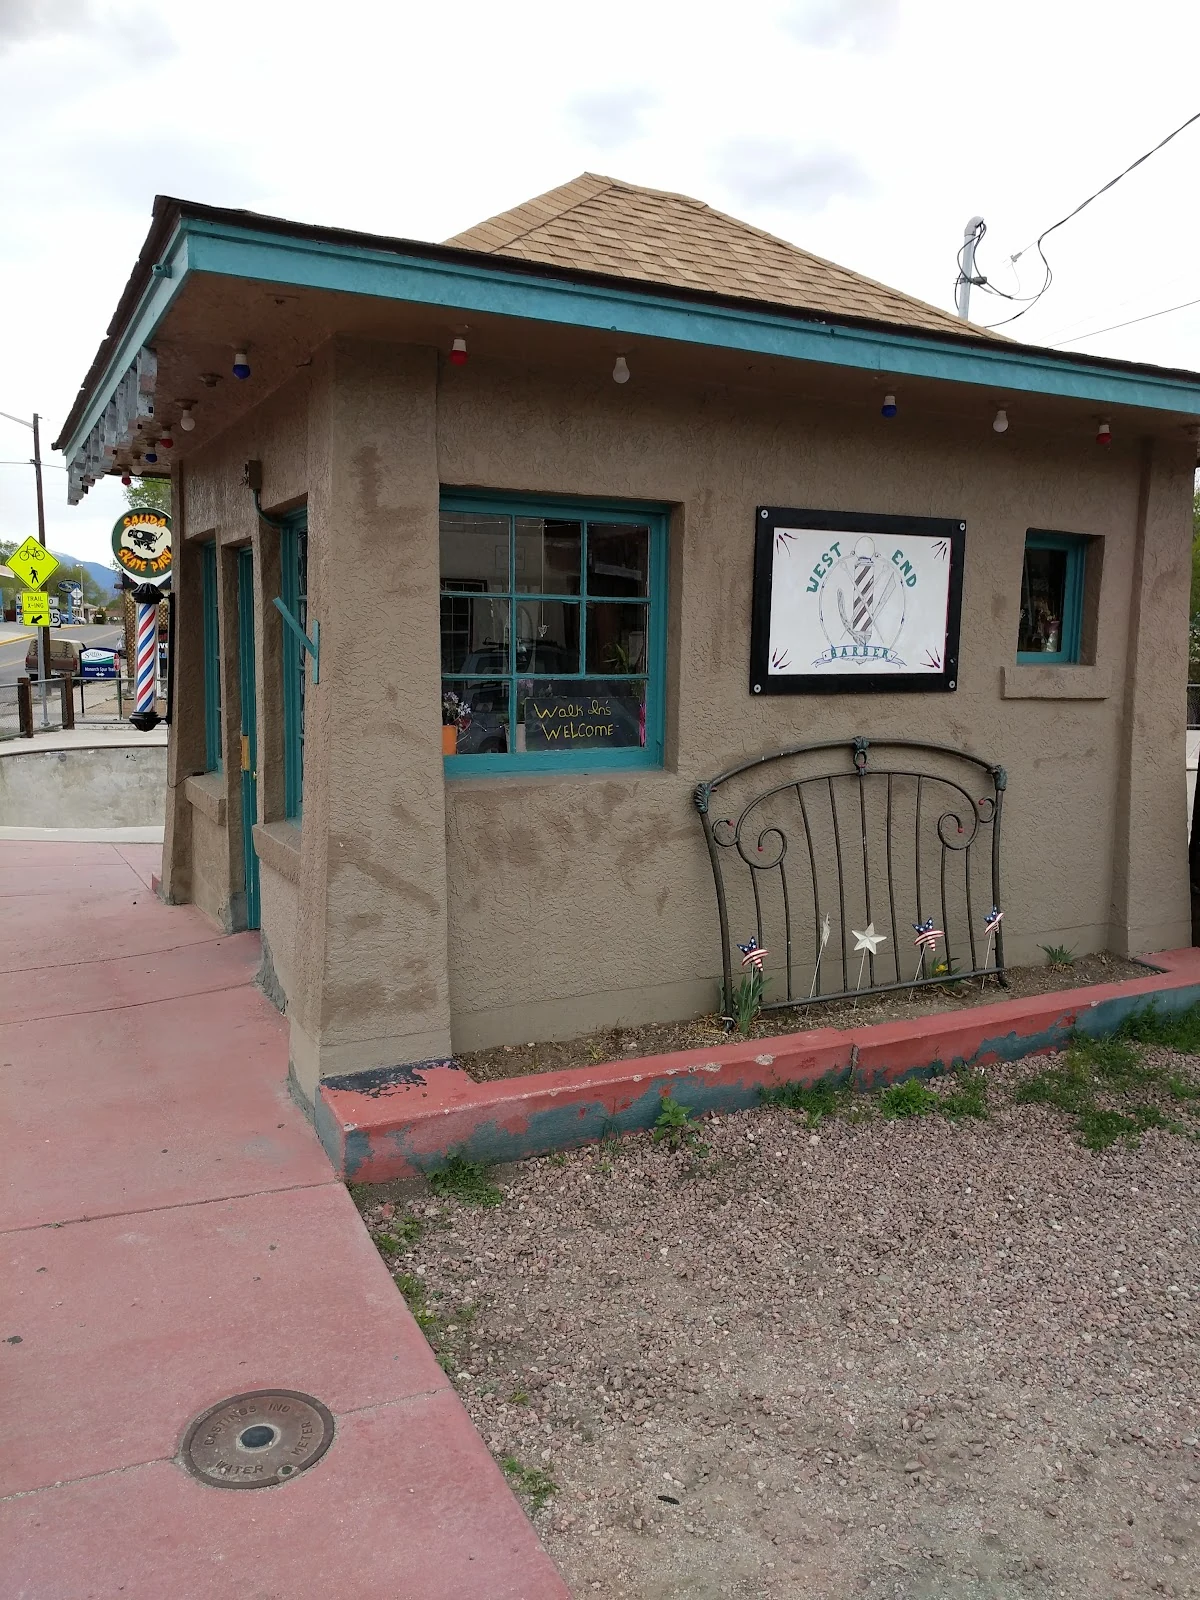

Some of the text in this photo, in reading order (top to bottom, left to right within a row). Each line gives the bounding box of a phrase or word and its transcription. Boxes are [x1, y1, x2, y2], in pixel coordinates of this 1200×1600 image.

[123, 515, 167, 528] SALIDA
[118, 549, 147, 573] SKATE
[806, 541, 918, 594] WEST END
[830, 646, 889, 659] BARBER
[533, 703, 583, 719] Walk
[541, 721, 614, 741] WELCOME
[215, 1421, 314, 1475] WATER METER
